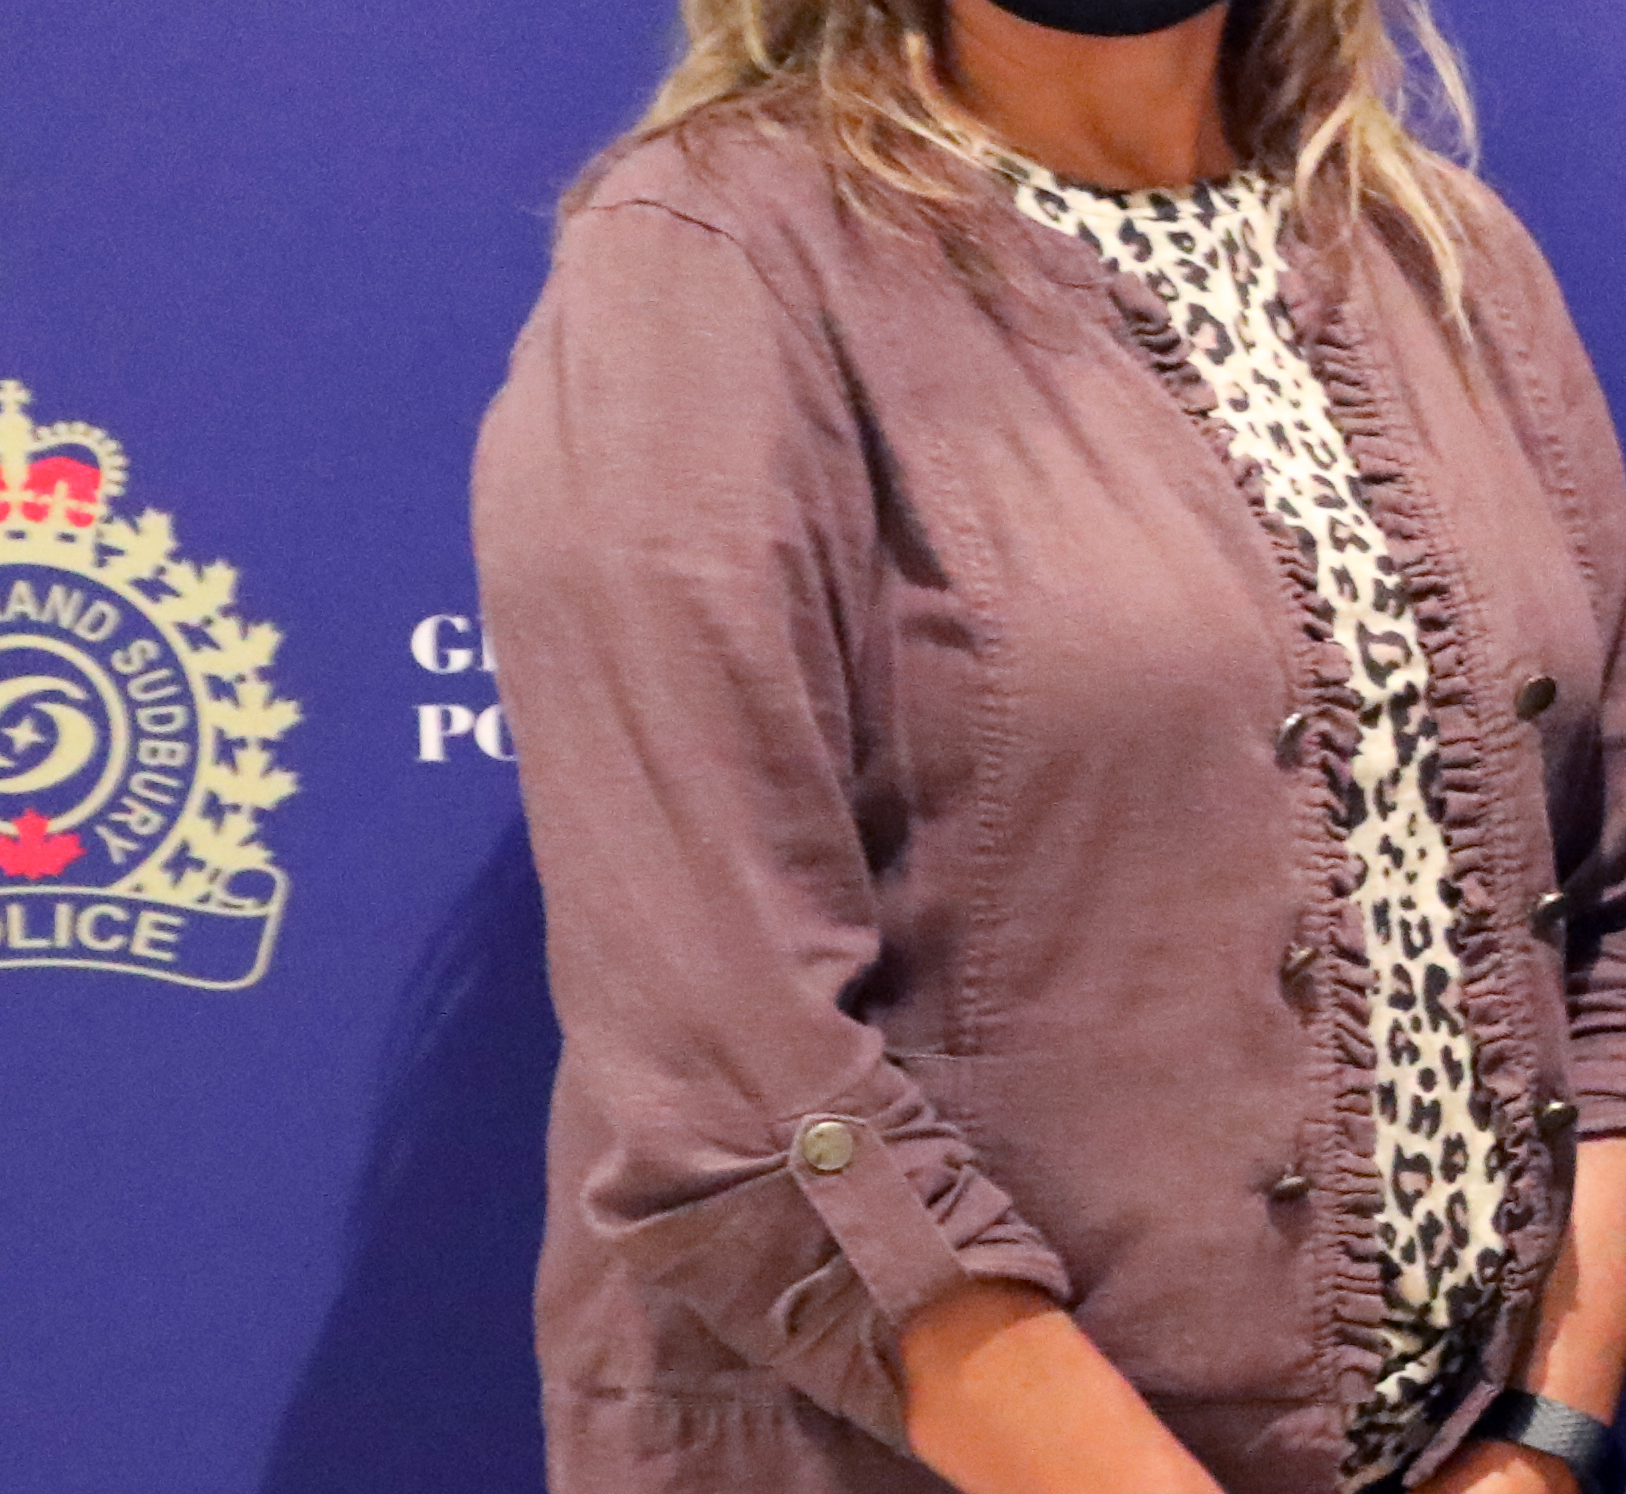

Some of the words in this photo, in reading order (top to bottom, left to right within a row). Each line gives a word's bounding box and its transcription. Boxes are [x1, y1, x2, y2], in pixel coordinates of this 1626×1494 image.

[0, 578, 120, 642] AND
[94, 637, 190, 864] SUDBURY
[0, 902, 184, 962] LICE
